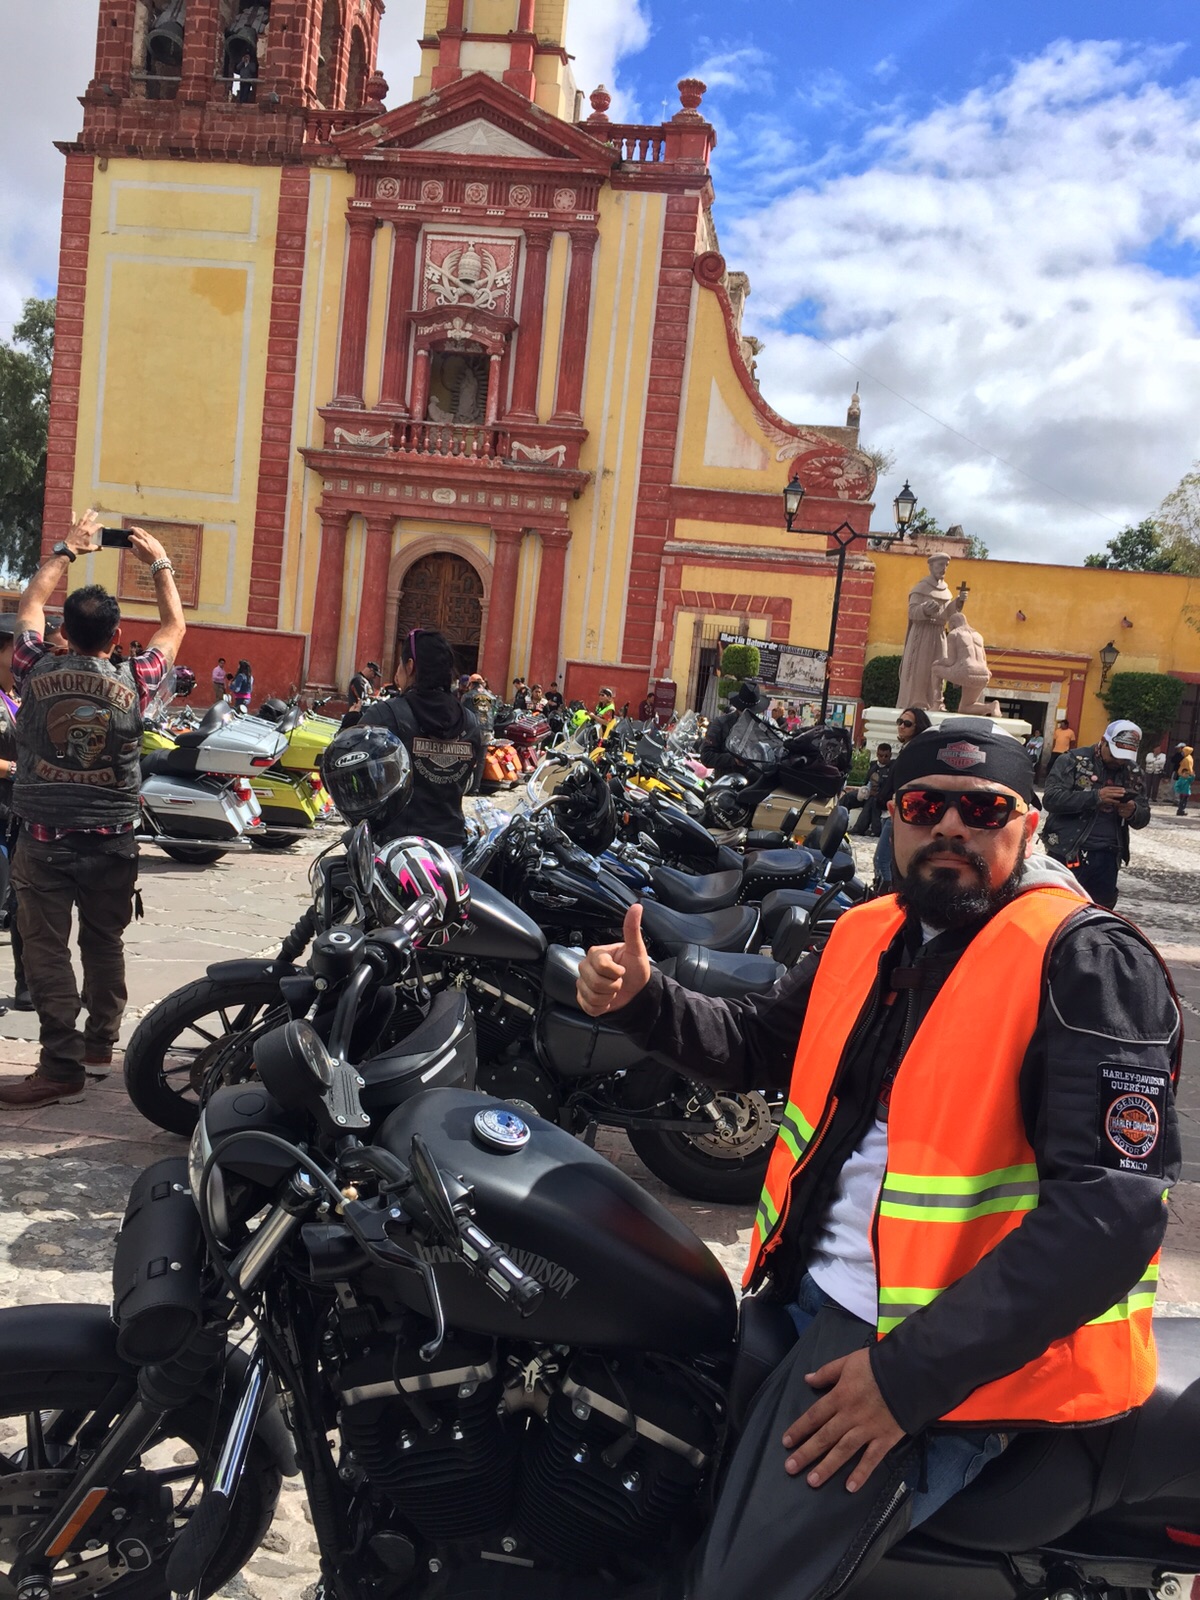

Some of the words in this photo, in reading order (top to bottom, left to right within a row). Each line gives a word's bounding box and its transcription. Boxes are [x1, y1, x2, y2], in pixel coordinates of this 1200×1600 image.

[33, 673, 135, 709] INMORTALES
[416, 741, 471, 755] HARLEY-DAVIDSON
[339, 752, 363, 765] HJC
[40, 764, 111, 783] MEXICO
[1102, 1069, 1165, 1087] HARLEY-DAVIDSON
[1111, 1080, 1160, 1095] QUERÉTARO
[1116, 1097, 1154, 1115] GENUINE
[1111, 1118, 1156, 1132] HARLEY-DAVIDSON
[1113, 1135, 1140, 1154] MOTOR
[1141, 1141, 1153, 1152] OIL
[1120, 1157, 1148, 1171] MÉXICO
